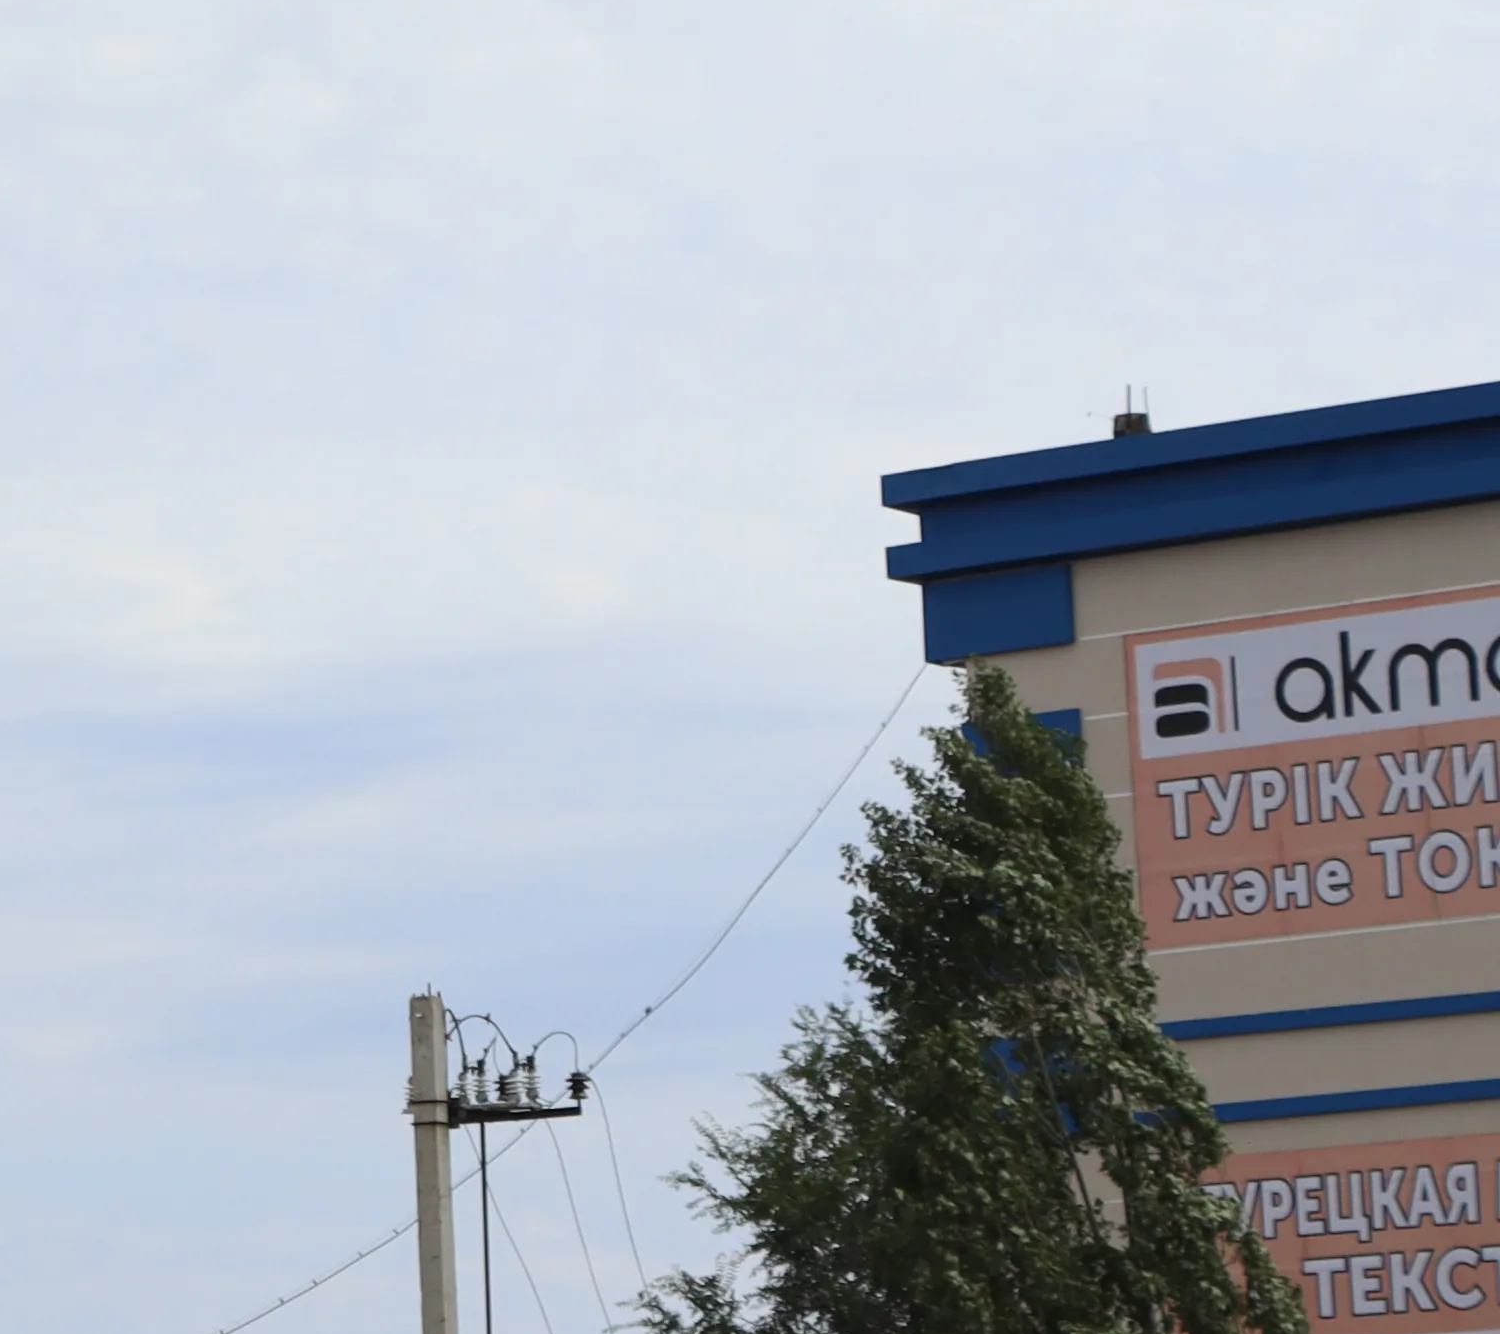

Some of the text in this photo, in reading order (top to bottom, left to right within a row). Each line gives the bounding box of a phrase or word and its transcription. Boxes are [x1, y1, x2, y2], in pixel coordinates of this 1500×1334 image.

[1274, 630, 1500, 723] akm
[1156, 756, 1364, 839] ТУРІК
[1172, 858, 1353, 922] және
